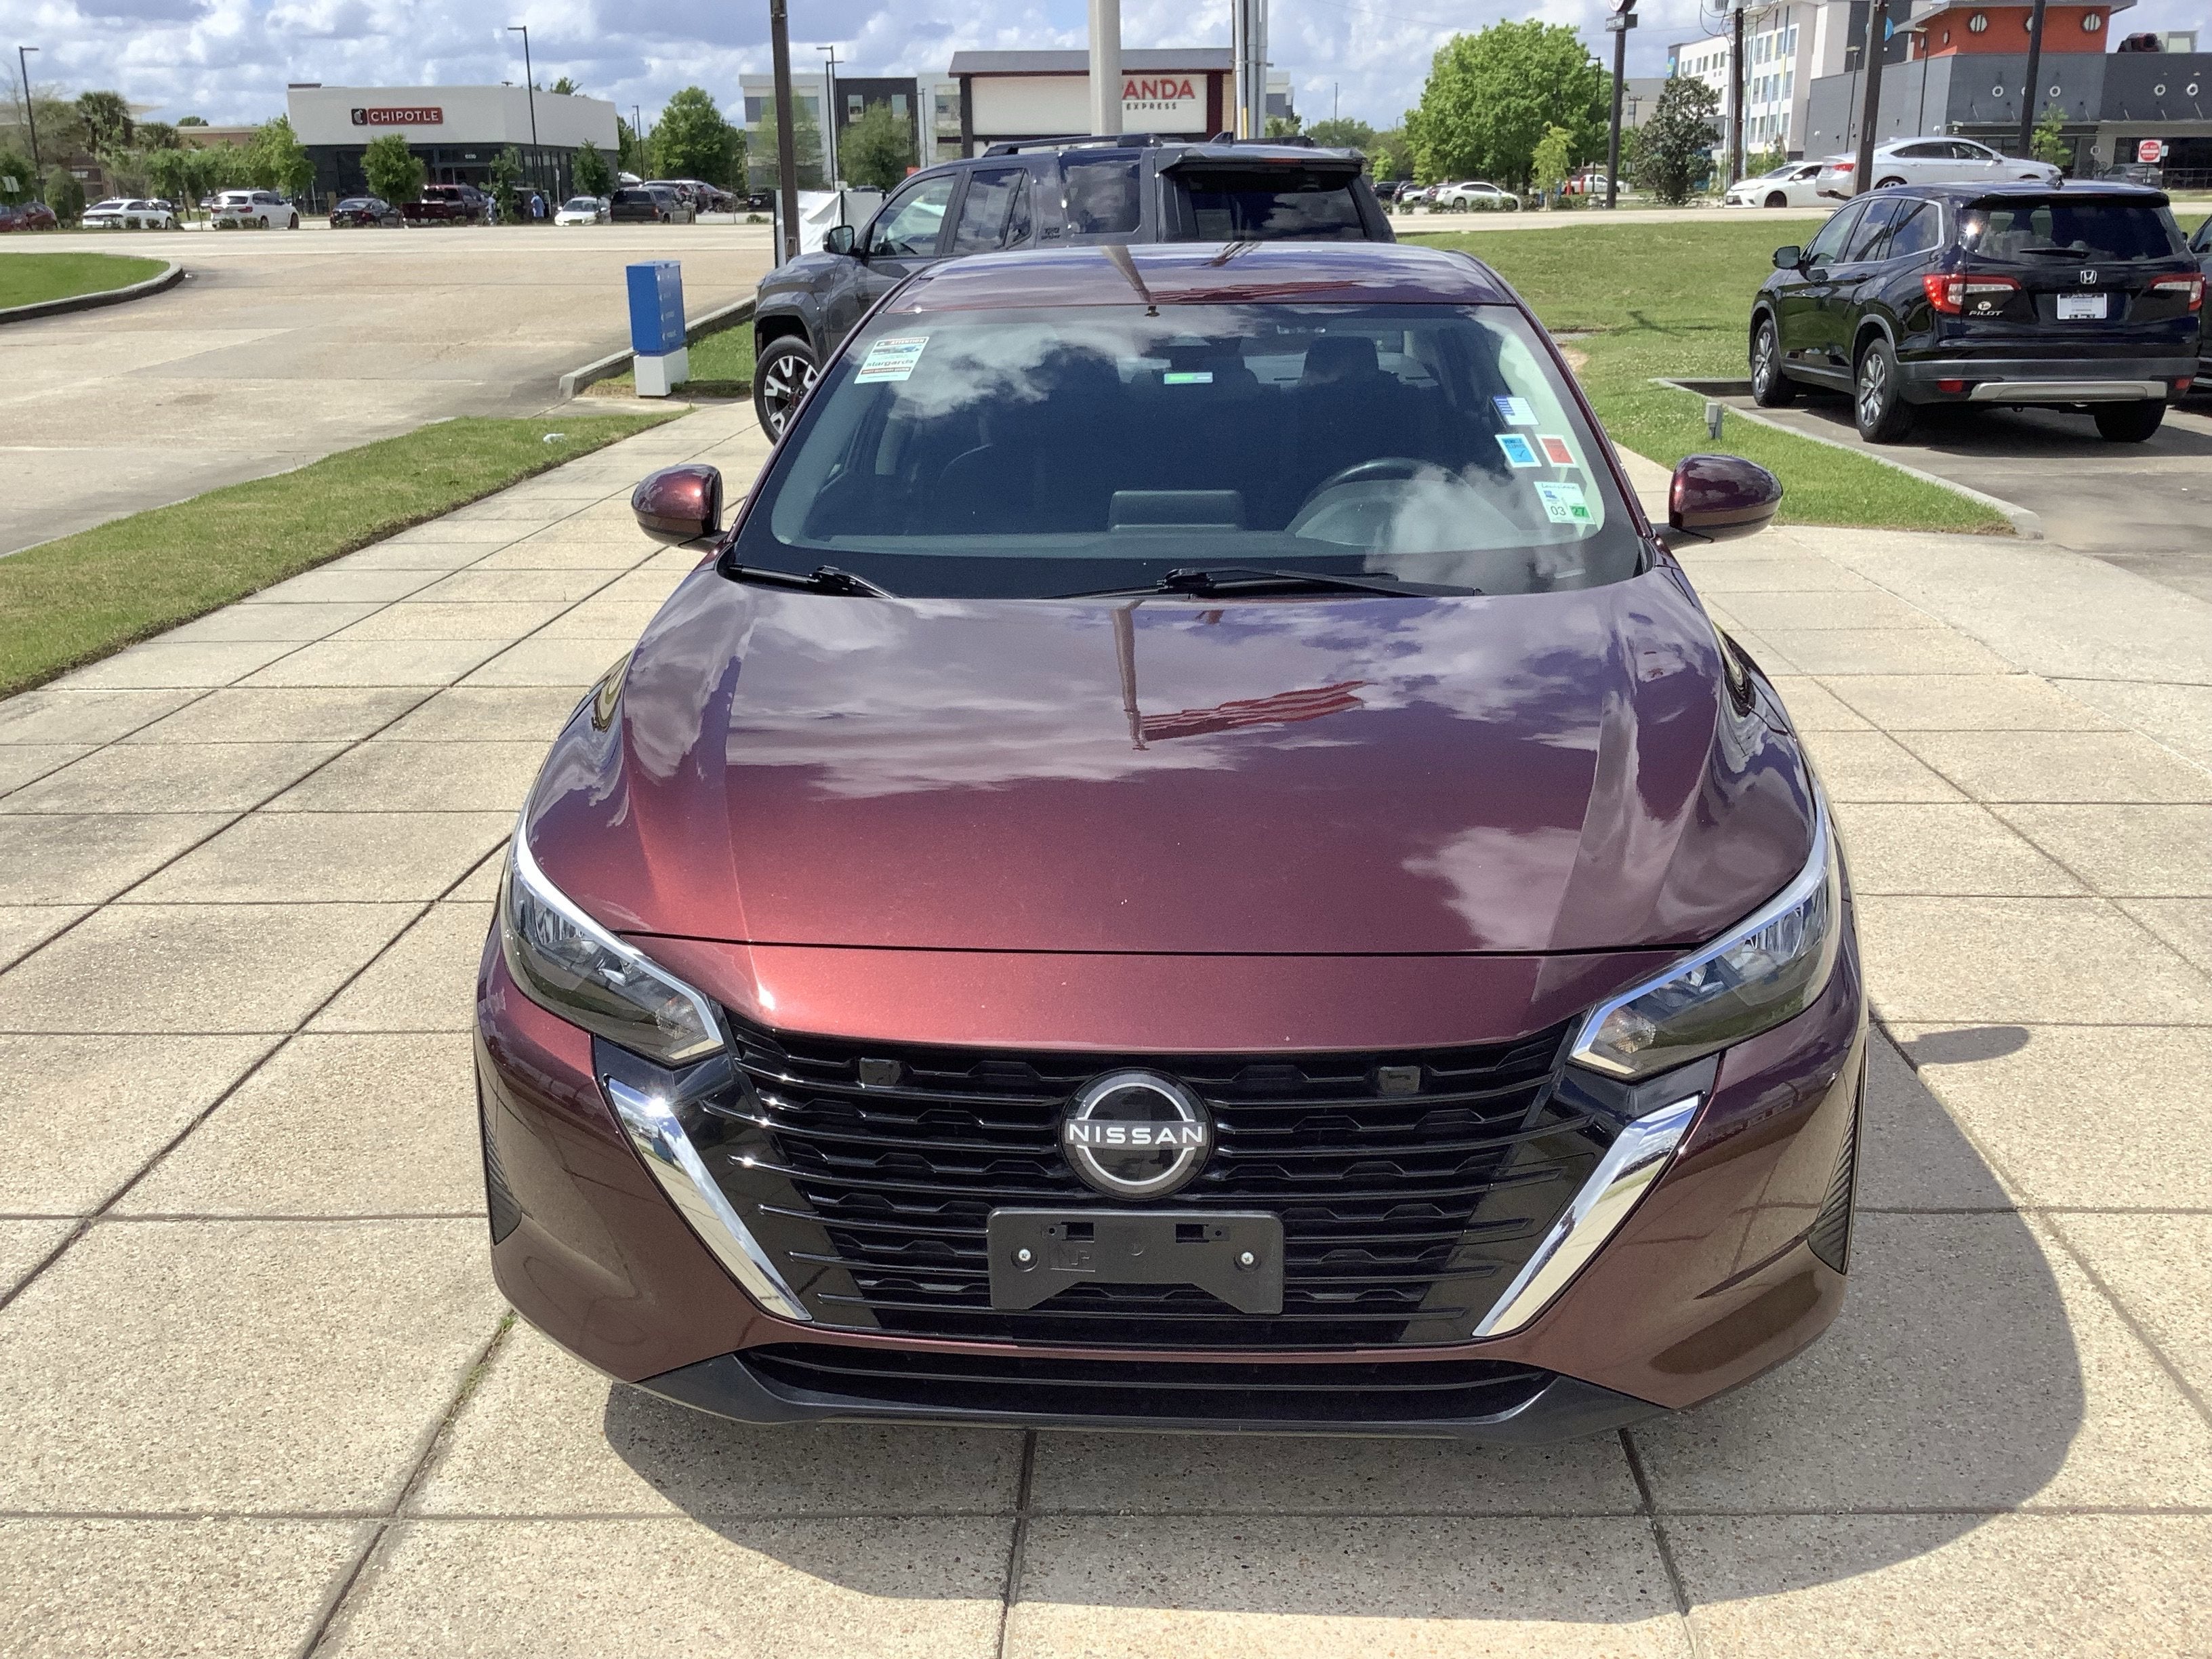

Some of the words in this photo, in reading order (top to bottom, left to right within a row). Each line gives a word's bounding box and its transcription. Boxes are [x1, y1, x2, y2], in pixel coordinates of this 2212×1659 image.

[1122, 78, 1196, 100] ANDA
[1126, 102, 1177, 110] EXPRESS
[370, 110, 439, 122] CHIPOTLE
[1551, 506, 1566, 516] 03
[1572, 506, 1585, 516] 27
[1069, 1123, 1203, 1145] NISSAN
